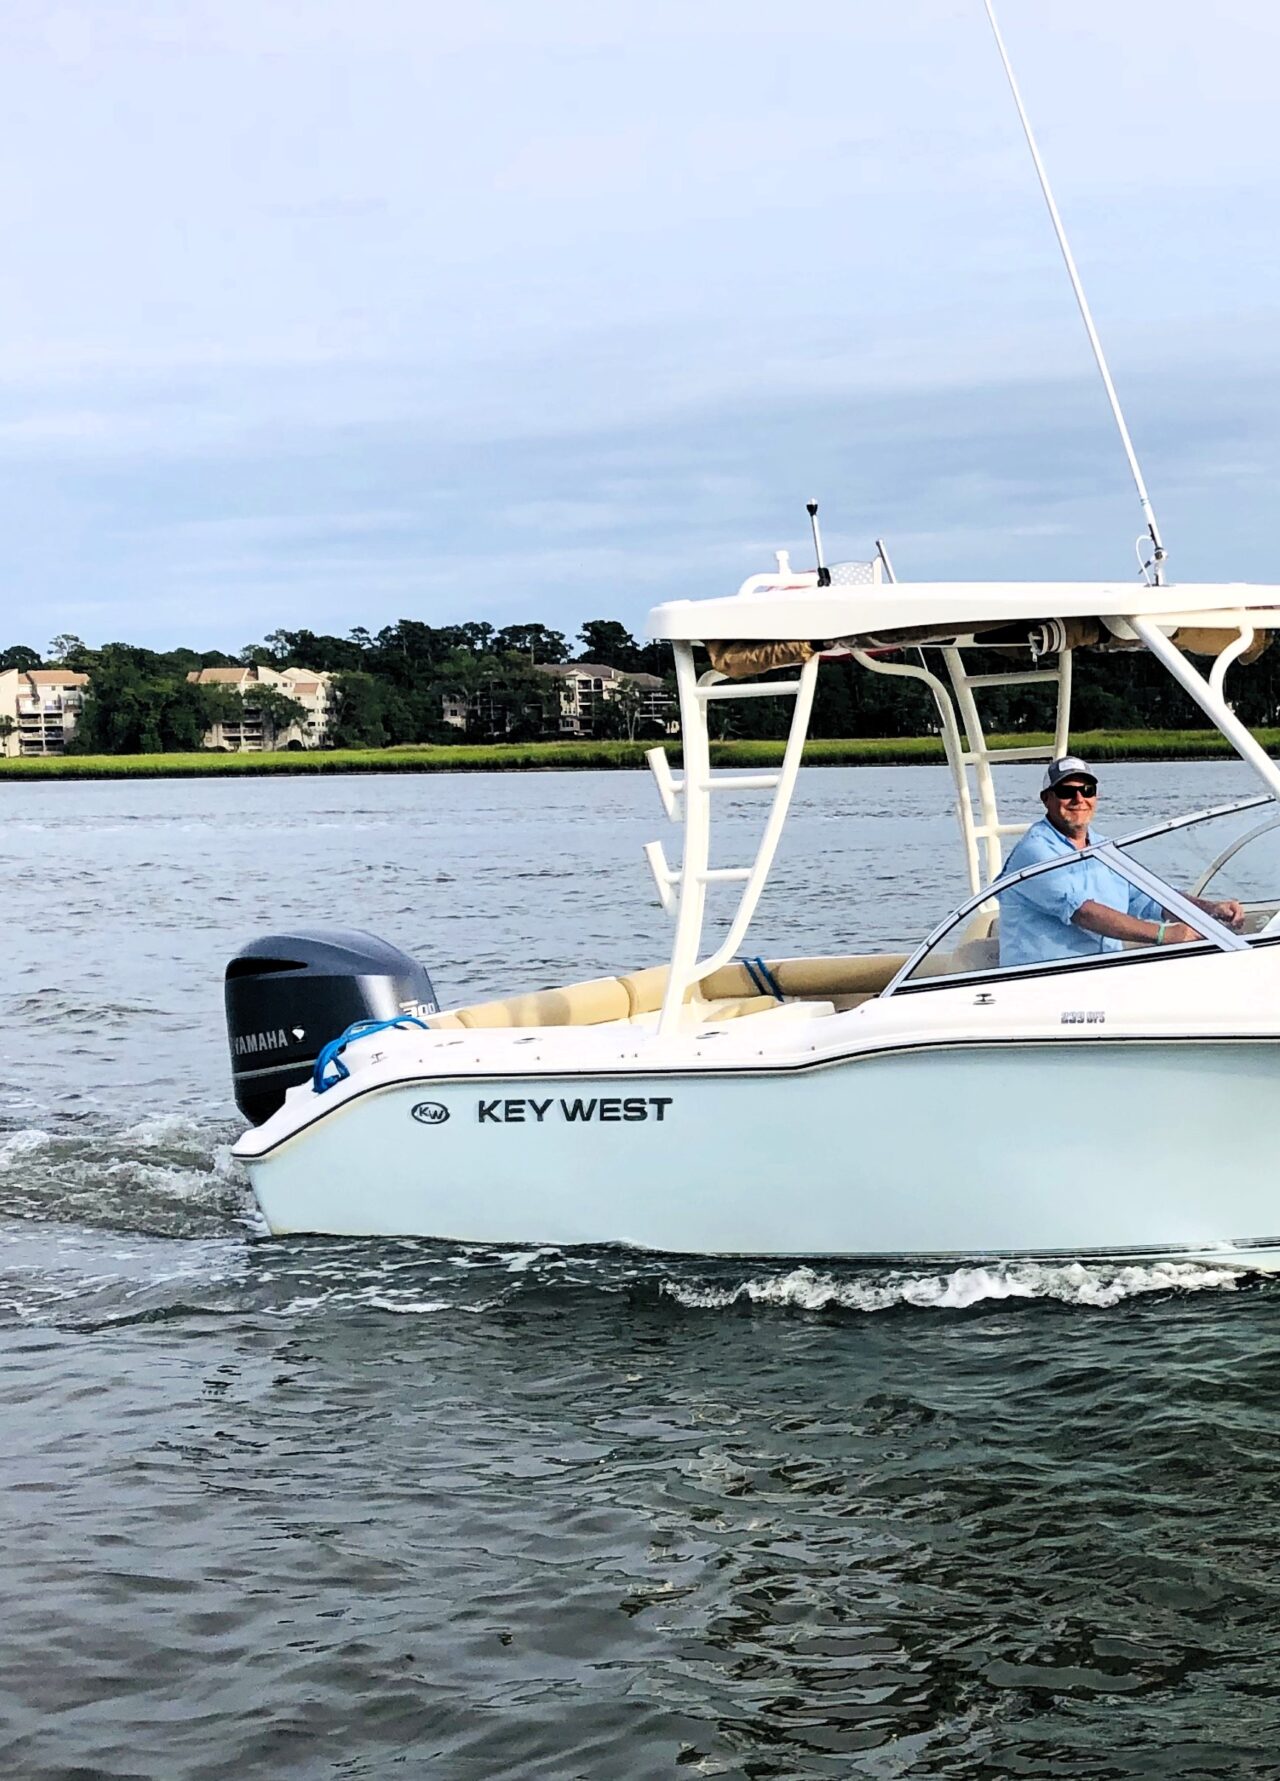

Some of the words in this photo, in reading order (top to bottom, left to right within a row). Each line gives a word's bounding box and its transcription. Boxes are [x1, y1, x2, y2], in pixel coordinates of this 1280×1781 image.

[419, 1106, 444, 1120] KW
[478, 1099, 554, 1123] KEY
[560, 1098, 673, 1122] WEST
